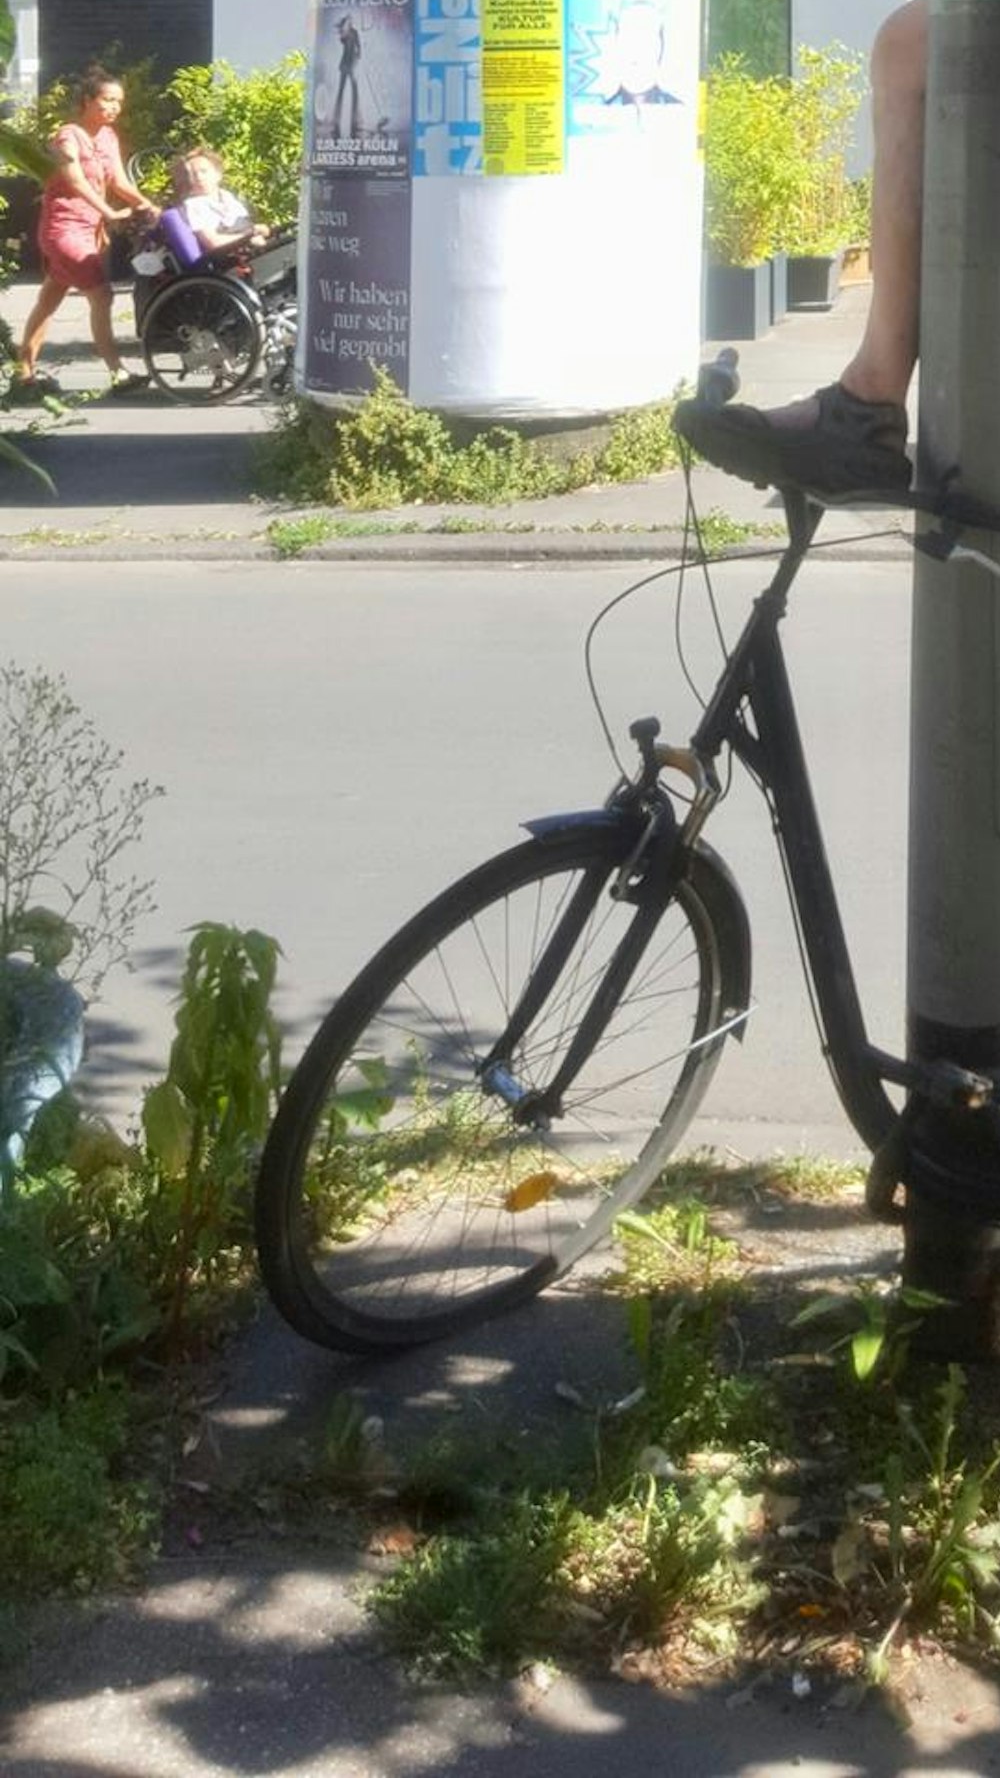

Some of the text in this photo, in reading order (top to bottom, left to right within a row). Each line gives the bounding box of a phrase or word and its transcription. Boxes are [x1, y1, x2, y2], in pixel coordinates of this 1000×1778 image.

[357, 154, 396, 166] arena
[319, 279, 408, 306] Wir haben
[333, 308, 409, 332] nur sehr
[313, 328, 407, 361] viel geprobt
